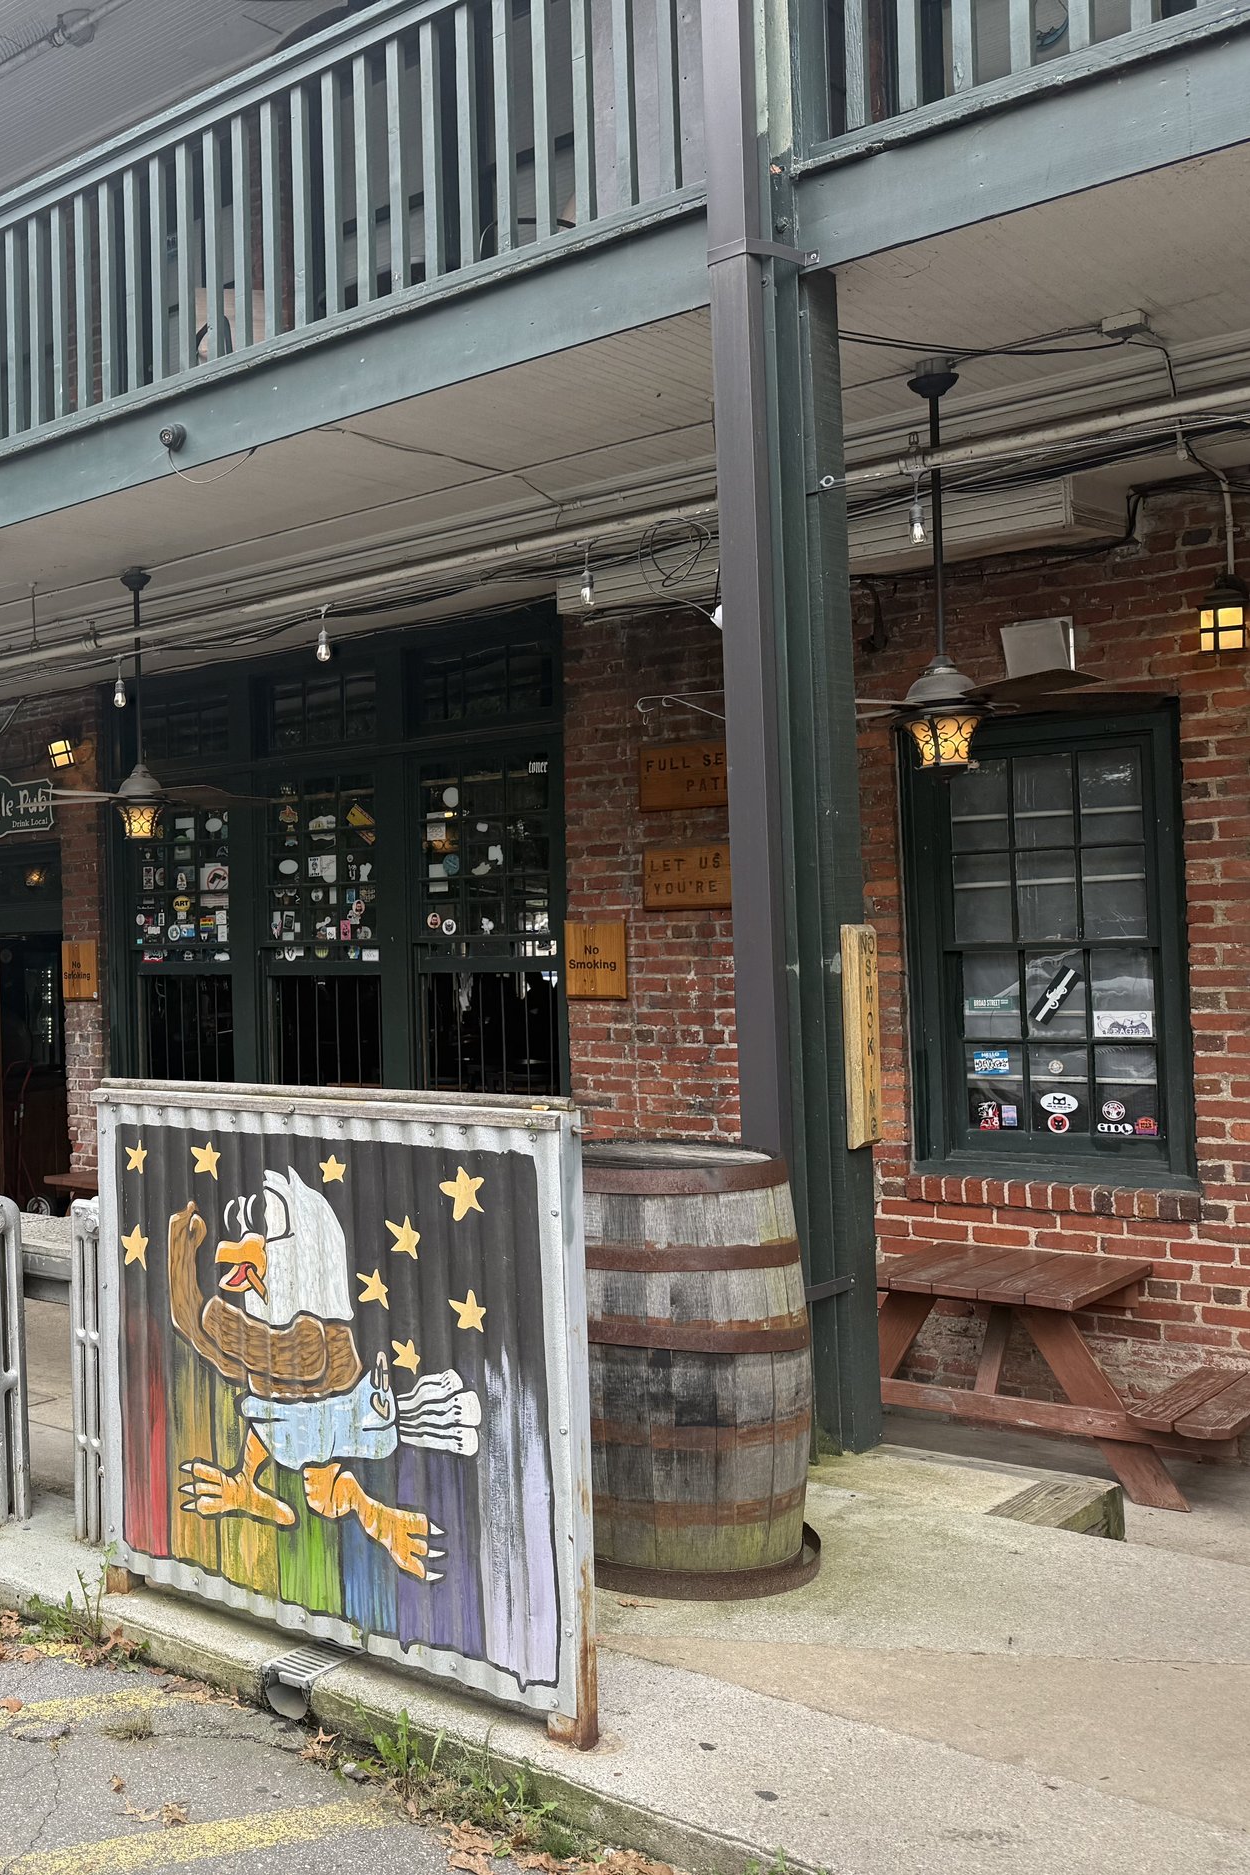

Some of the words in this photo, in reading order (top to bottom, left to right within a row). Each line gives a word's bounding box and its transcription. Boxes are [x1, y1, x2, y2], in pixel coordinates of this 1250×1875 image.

[646, 757, 690, 773] FULL
[703, 752, 724, 767] SE
[18, 787, 47, 815] Pub
[12, 819, 30, 828] Drink
[31, 817, 48, 826] Local
[650, 858, 686, 872] LET
[699, 855, 721, 869] US
[653, 880, 718, 895] YOU'RE
[584, 944, 600, 955] No
[859, 933, 875, 955] NO
[71, 961, 82, 969] No
[568, 958, 617, 972] Smoking
[63, 971, 91, 981] Smoking
[865, 958, 878, 1138] SMOKING
